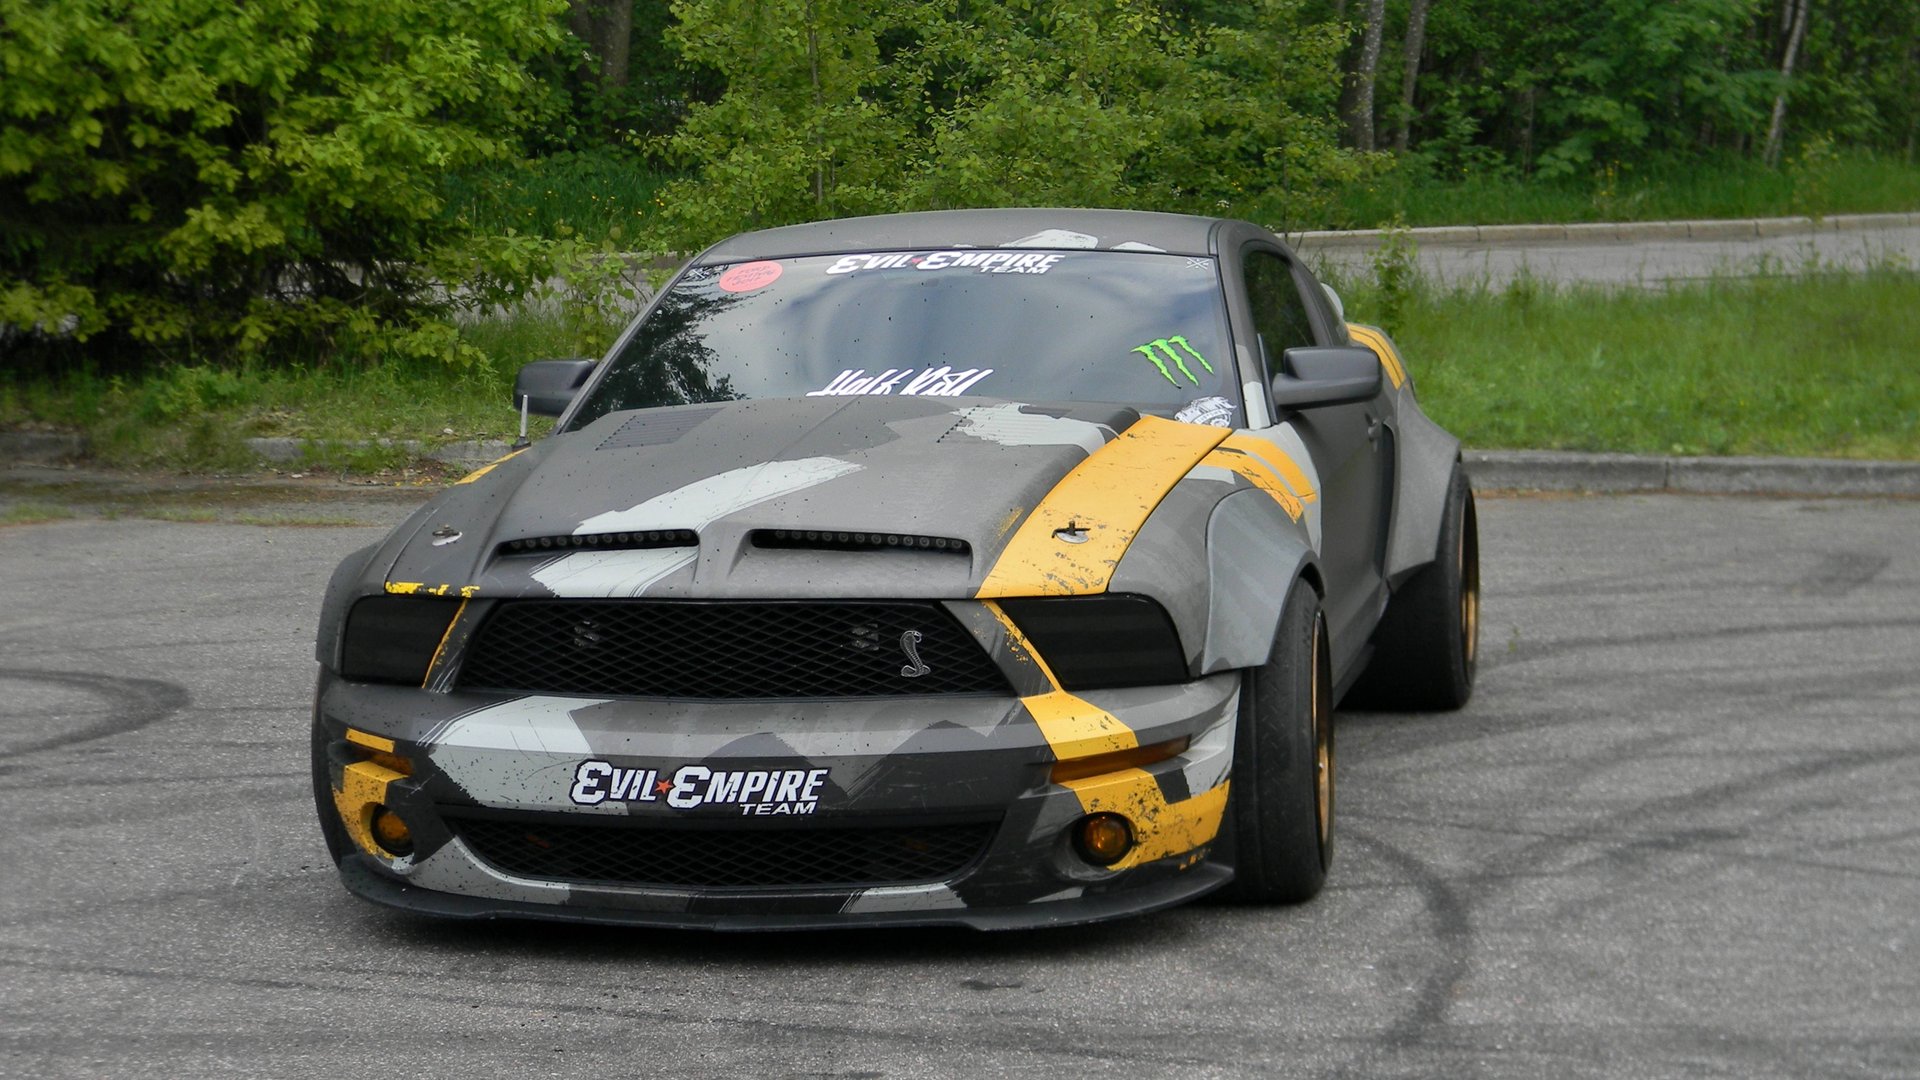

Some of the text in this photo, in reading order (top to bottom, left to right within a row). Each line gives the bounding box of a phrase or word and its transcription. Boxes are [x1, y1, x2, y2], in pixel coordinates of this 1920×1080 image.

[826, 251, 1065, 275] EVIL EMPIRE
[979, 264, 1050, 274] TEAM
[571, 760, 828, 809] EVIL EMPIRE
[739, 801, 817, 816] TEAM
